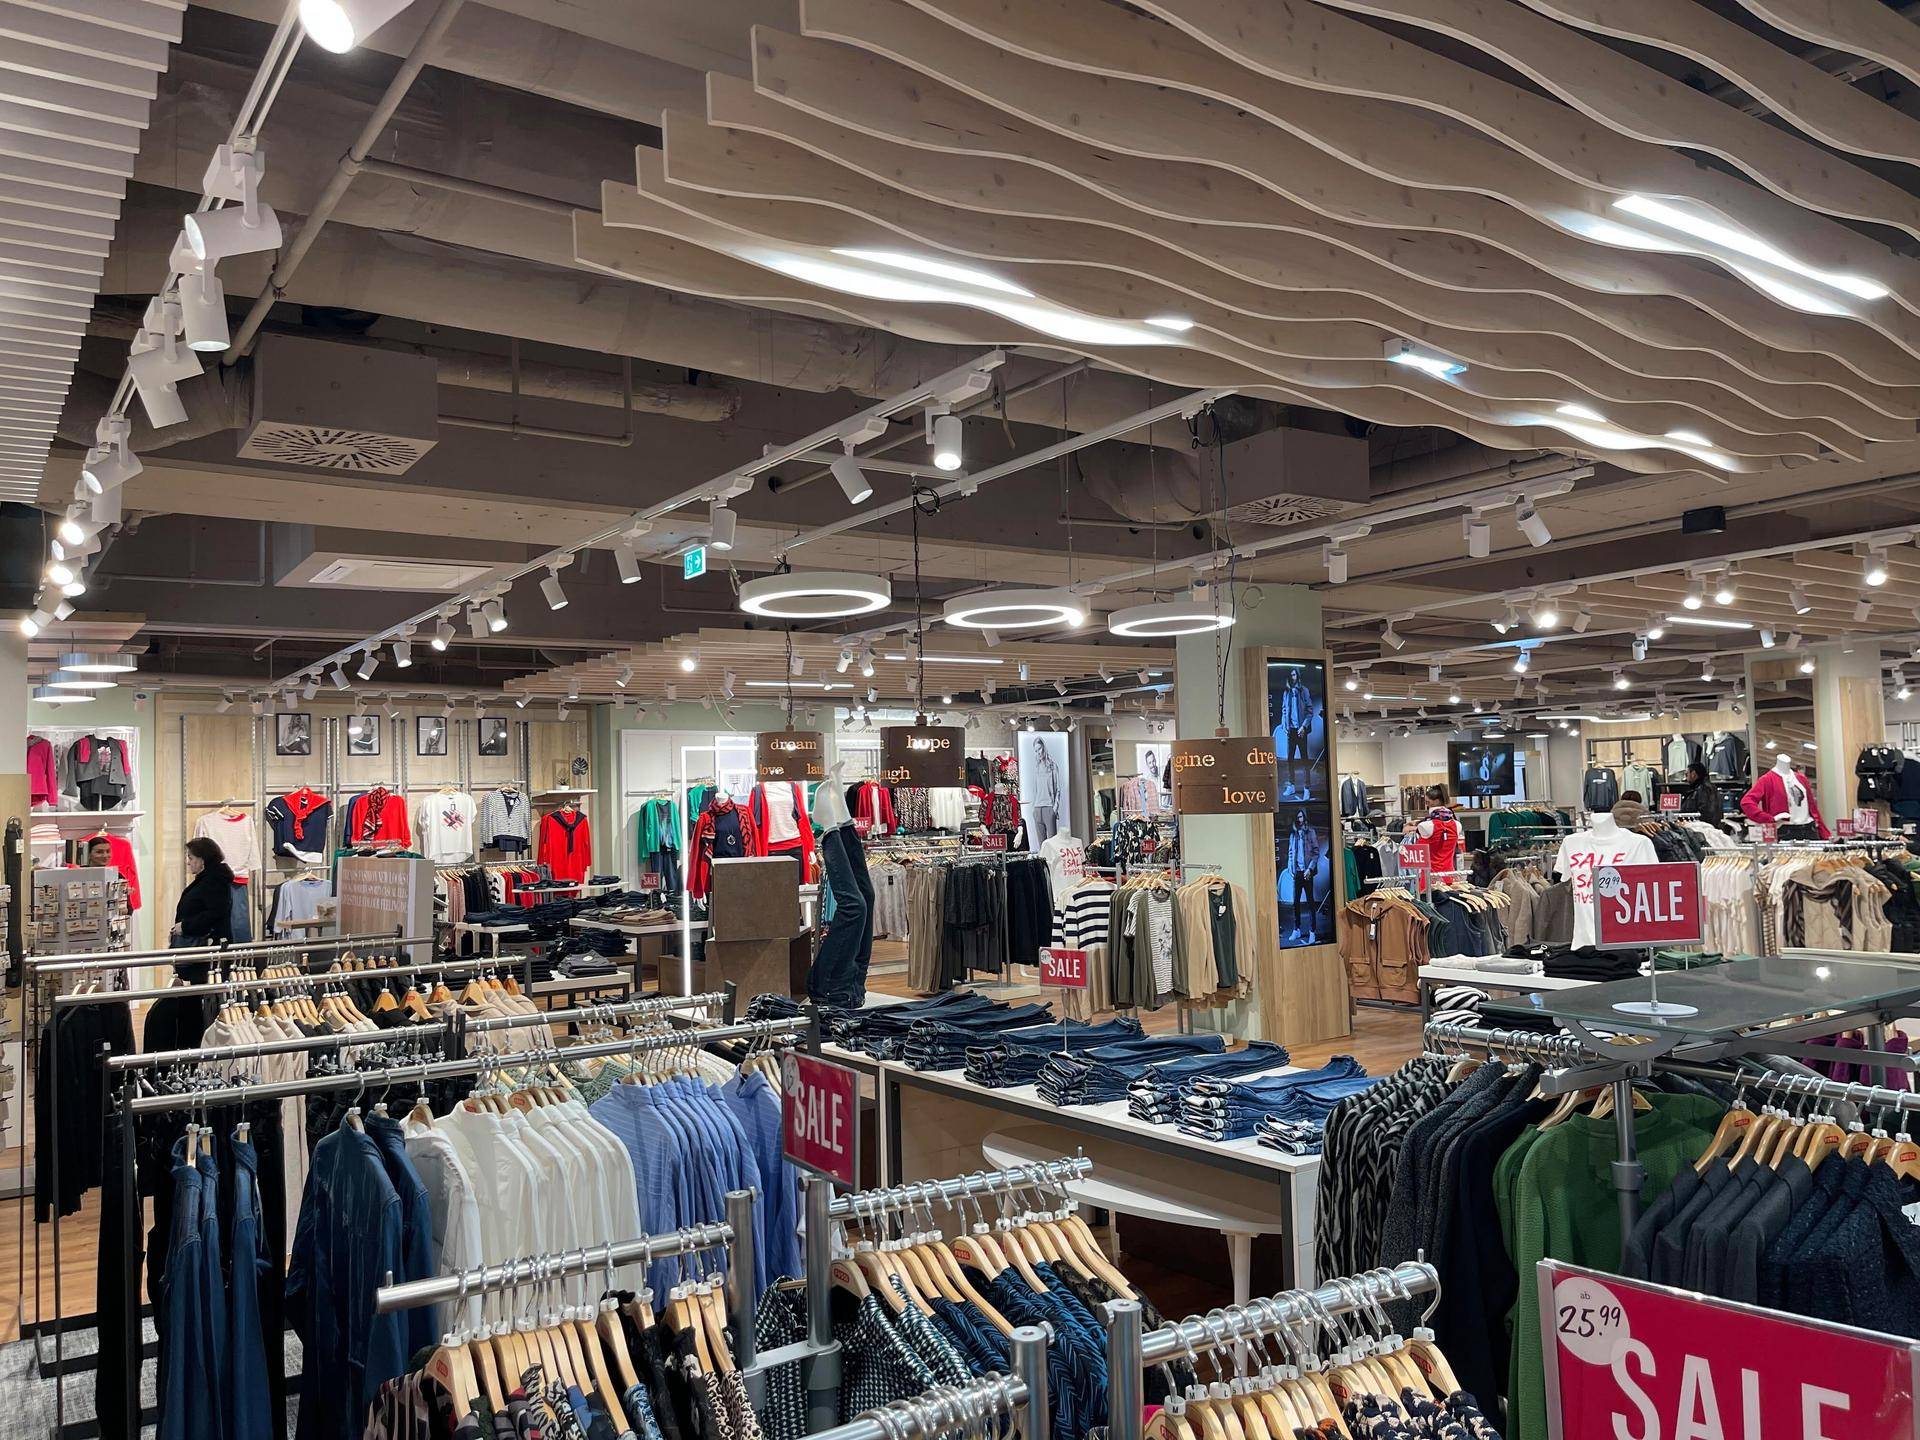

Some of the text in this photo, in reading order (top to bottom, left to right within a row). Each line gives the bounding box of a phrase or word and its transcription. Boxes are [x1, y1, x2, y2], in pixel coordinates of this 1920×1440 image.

[770, 738, 817, 751] dream
[906, 735, 950, 753] hope
[1174, 747, 1276, 772] gine dre
[1222, 786, 1266, 804] love
[1663, 797, 1678, 807] SALE
[986, 837, 1003, 847] SALE
[1060, 846, 1082, 858] SALE
[1403, 849, 1425, 863] SALE
[1615, 880, 1685, 924] SALE
[1048, 957, 1081, 978] SALE
[793, 1080, 843, 1155] SALE
[1580, 1291, 1591, 1300] ab
[1559, 1305, 1621, 1338] 25.99
